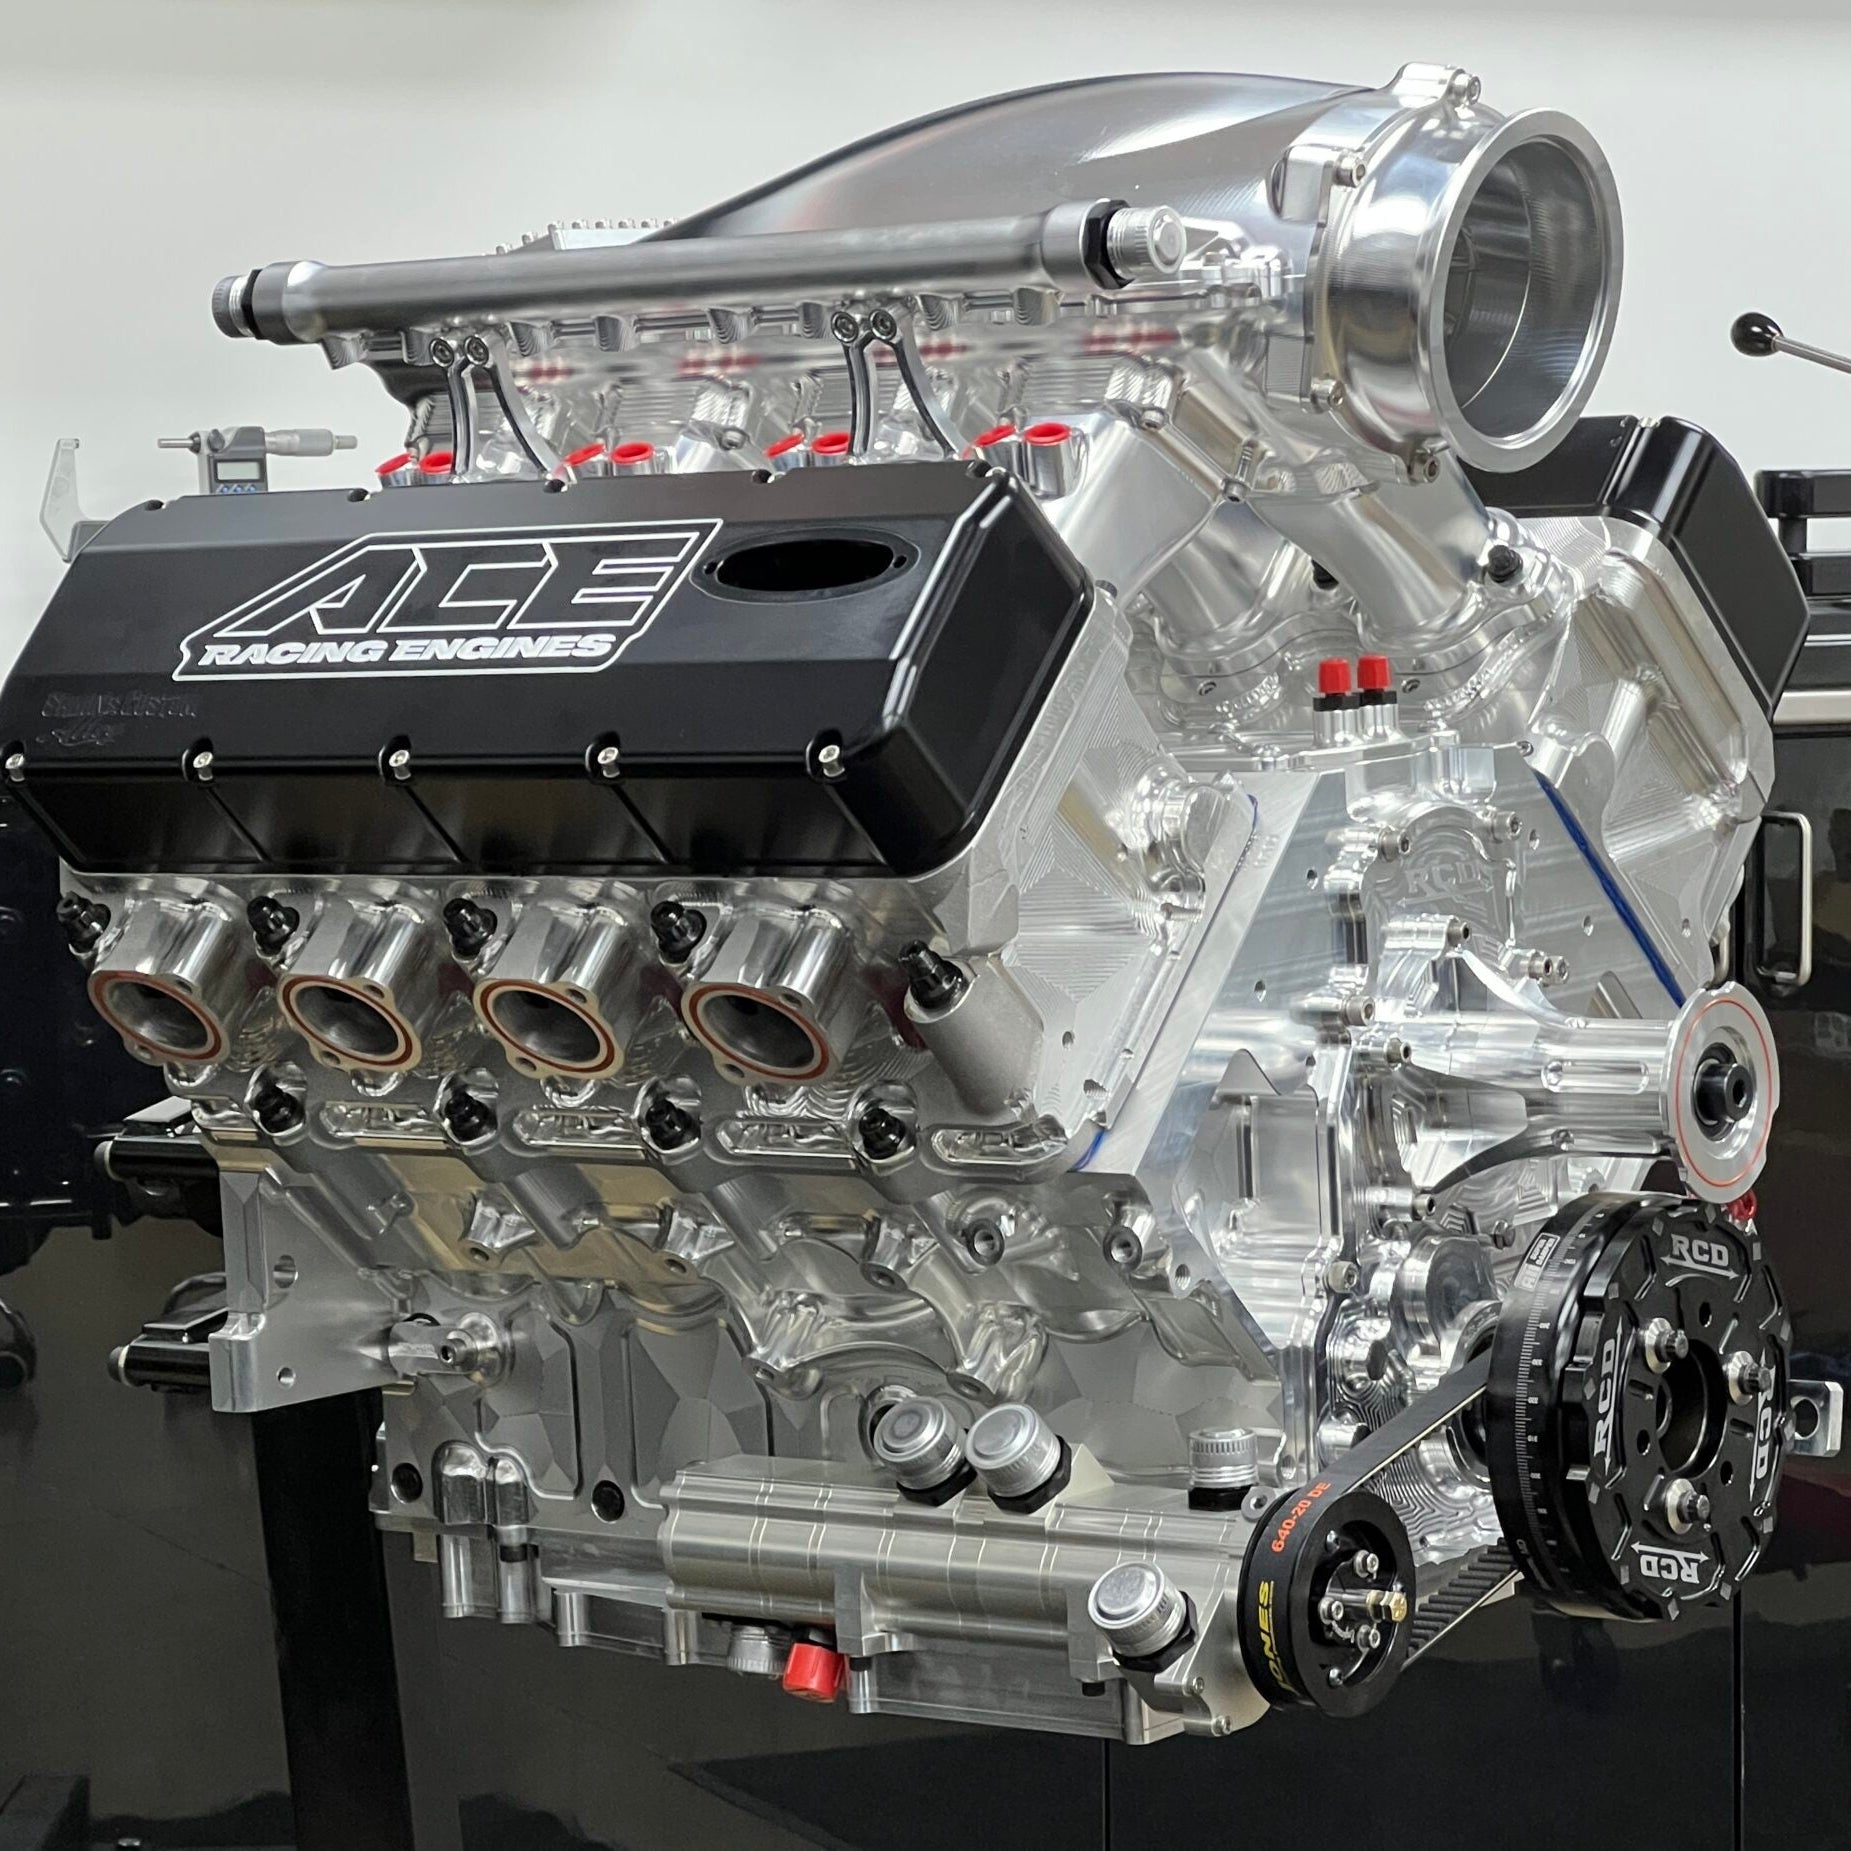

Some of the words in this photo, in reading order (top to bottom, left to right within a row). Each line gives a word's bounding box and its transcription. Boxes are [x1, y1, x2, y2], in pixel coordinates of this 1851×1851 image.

[213, 532, 699, 637] ACE
[198, 639, 389, 667] RACING
[388, 633, 617, 662] ENGINES
[1669, 1233, 1730, 1268] RCD
[1594, 1338, 1616, 1457] RCD
[1271, 1499, 1312, 1553] 640-20
[1640, 1554, 1700, 1584] RCD
